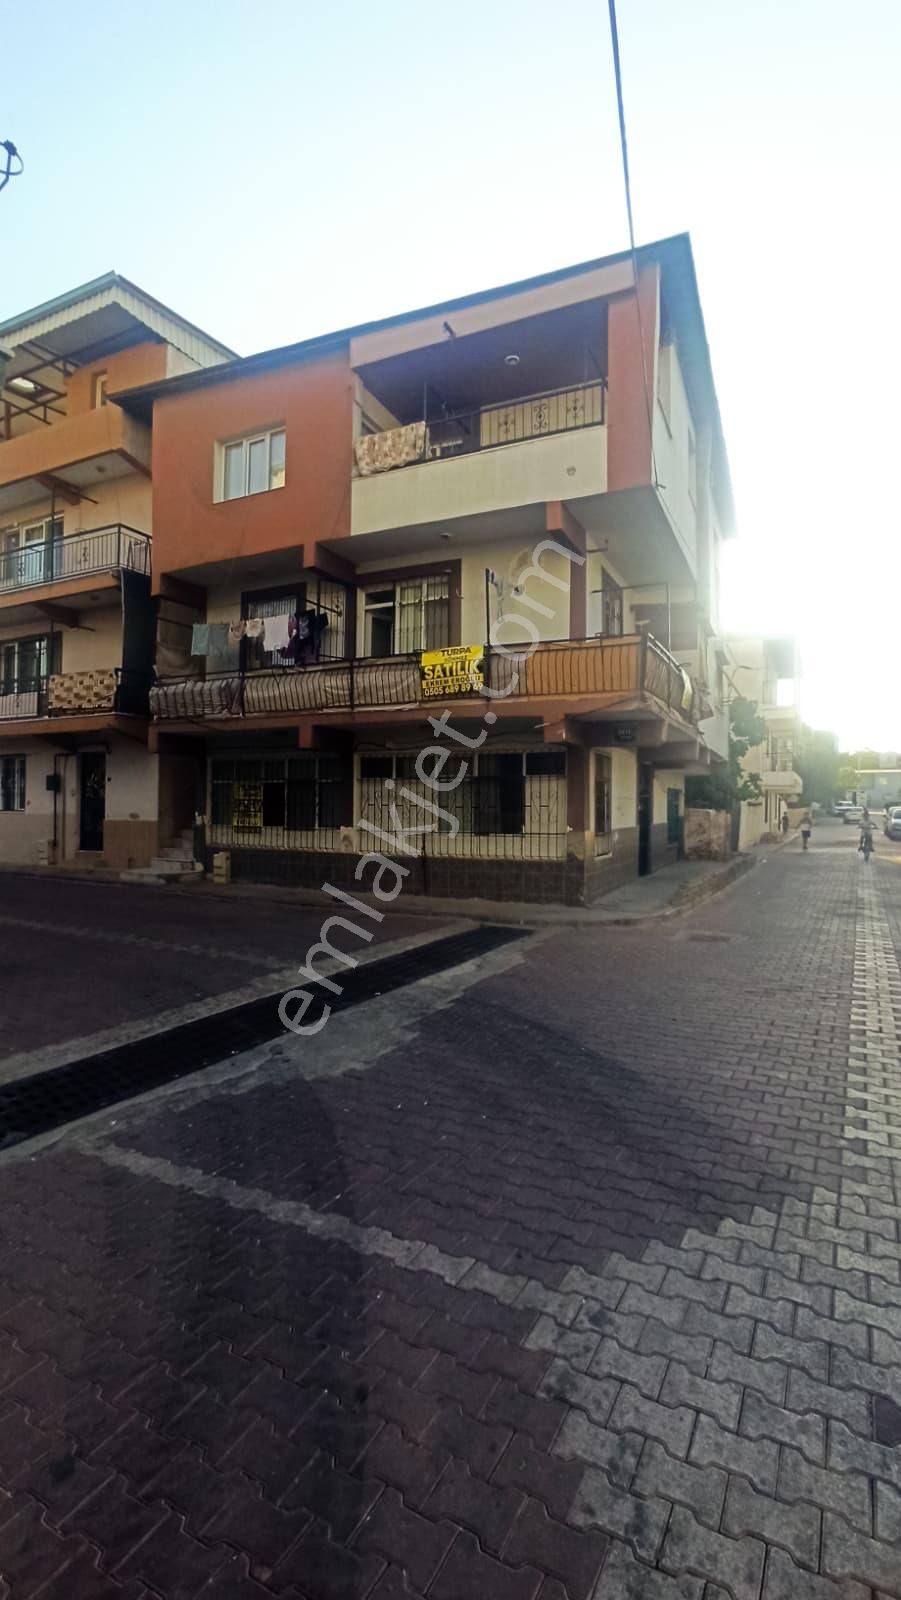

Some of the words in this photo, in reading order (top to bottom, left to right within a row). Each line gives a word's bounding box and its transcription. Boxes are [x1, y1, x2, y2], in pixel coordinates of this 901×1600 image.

[441, 647, 472, 656] TURPA
[424, 660, 480, 679] SATILIK
[424, 687, 443, 696] 0505
